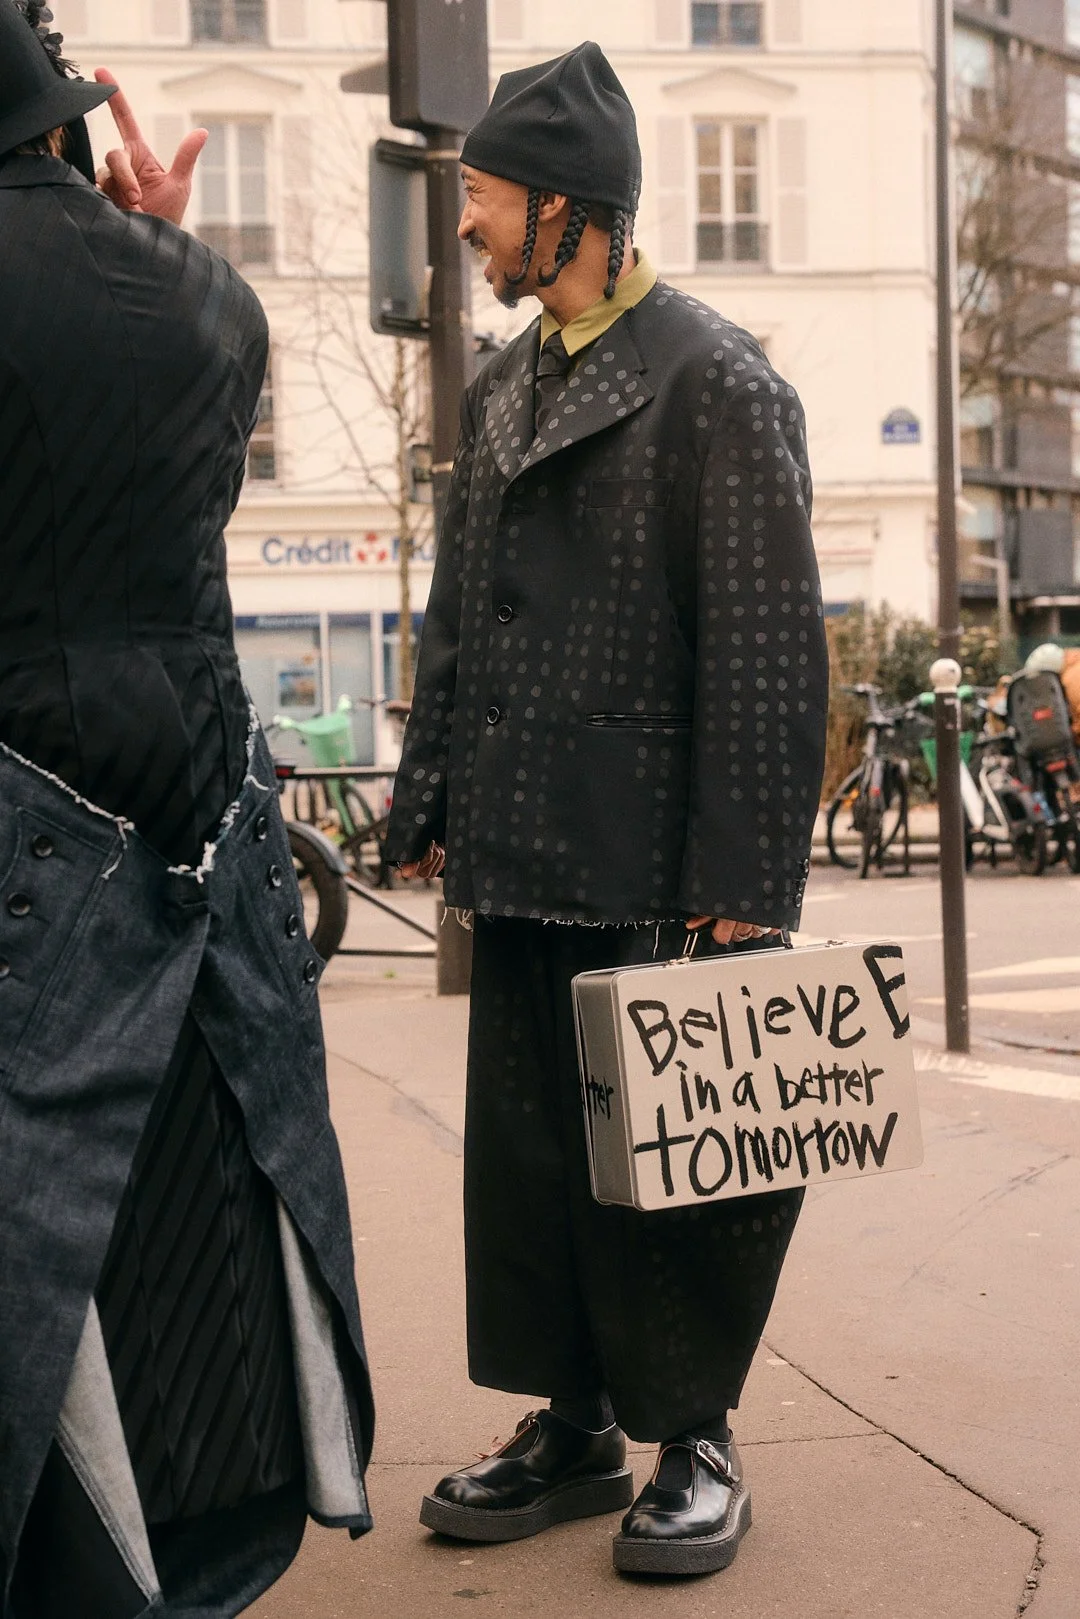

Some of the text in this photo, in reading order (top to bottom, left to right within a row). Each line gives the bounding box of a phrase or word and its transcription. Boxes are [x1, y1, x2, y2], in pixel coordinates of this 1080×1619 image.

[262, 536, 351, 564] Crédit
[627, 984, 866, 1076] Believe
[675, 1059, 884, 1122] in a better
[633, 1103, 898, 1197] tomorrow
